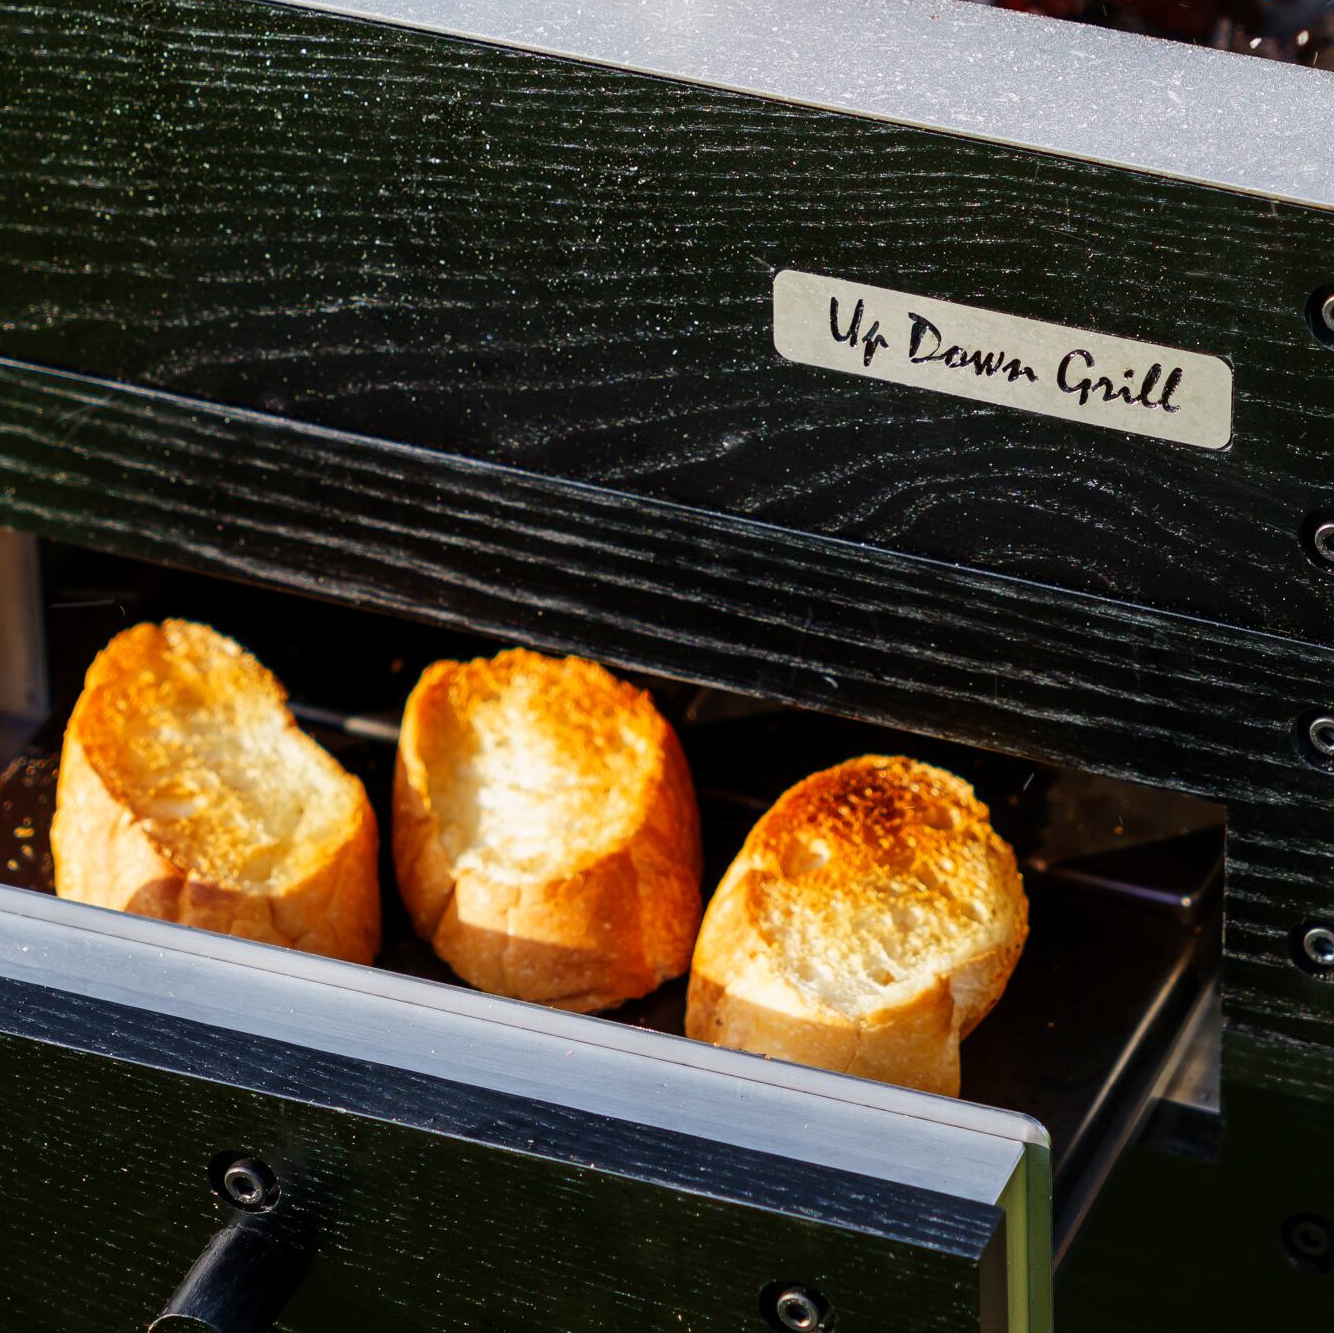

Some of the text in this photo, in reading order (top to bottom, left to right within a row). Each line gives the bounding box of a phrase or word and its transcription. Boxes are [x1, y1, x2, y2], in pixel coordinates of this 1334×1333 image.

[829, 295, 1183, 415] Up Down Grill
